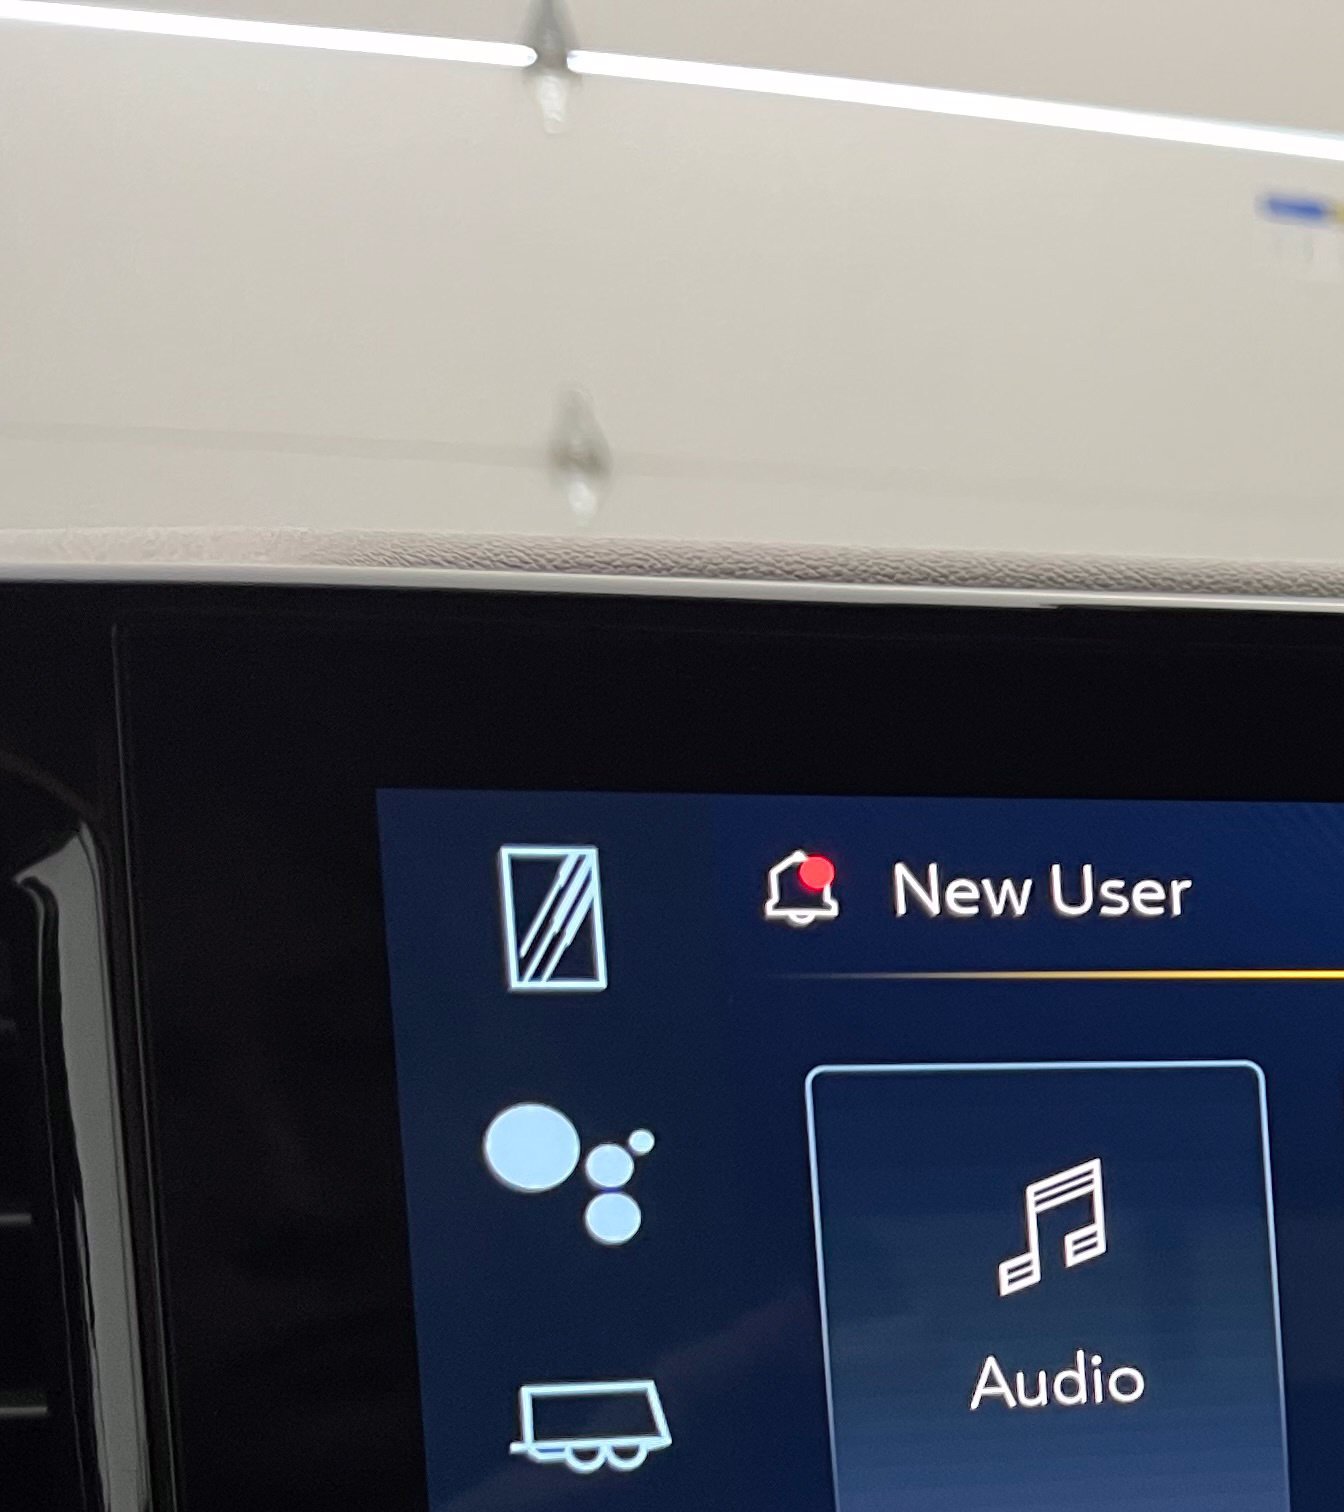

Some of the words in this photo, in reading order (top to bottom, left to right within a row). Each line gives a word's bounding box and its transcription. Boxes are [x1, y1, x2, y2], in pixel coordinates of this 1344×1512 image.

[893, 861, 1033, 918] New
[1050, 862, 1194, 918] User
[969, 1348, 1146, 1412] Audio
